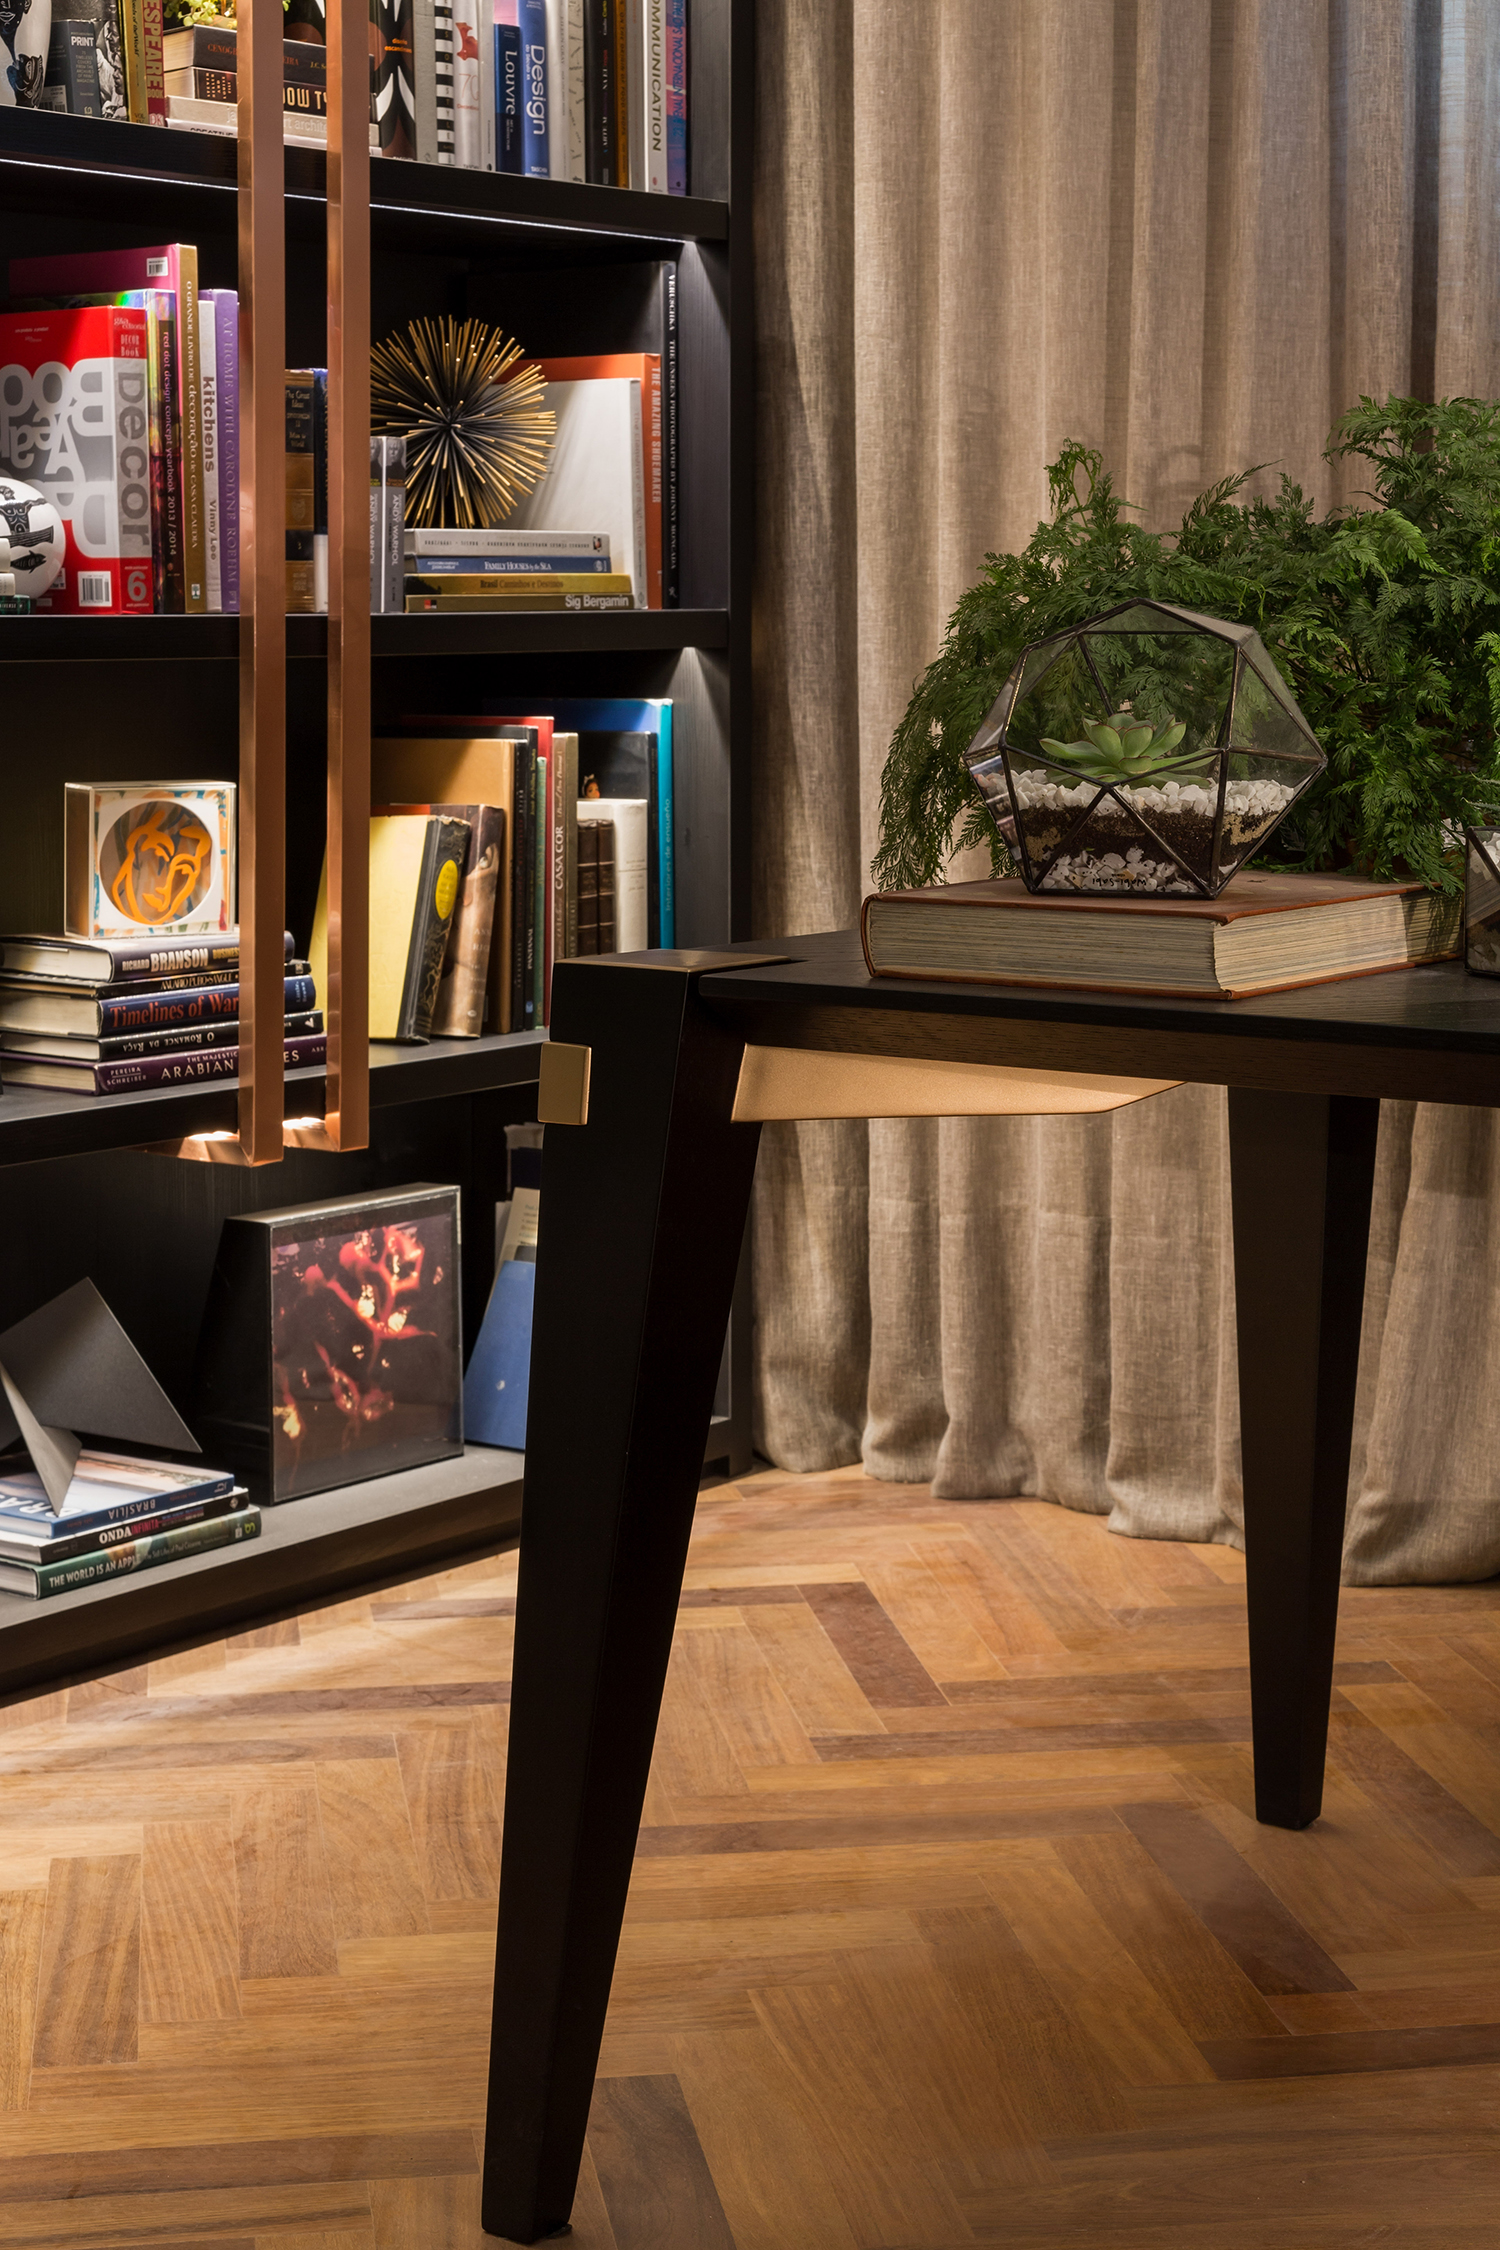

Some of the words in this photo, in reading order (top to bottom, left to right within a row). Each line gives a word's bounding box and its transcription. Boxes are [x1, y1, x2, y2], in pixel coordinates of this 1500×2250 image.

[71, 36, 94, 47] PRINT
[504, 50, 518, 115] Louvre
[525, 45, 546, 135] Design
[149, 113, 164, 126] DK
[668, 274, 676, 331] VERUSCHKA
[163, 350, 171, 368] dot
[188, 367, 195, 382] DE
[223, 342, 234, 388] HOME
[162, 370, 173, 403] design
[651, 366, 661, 386] THE
[163, 405, 174, 445] concept
[187, 384, 199, 459] decoração
[202, 375, 216, 473] kitchens
[224, 393, 236, 434] WITH
[651, 389, 661, 437] AMAZING
[117, 371, 151, 547] Decor
[165, 447, 176, 494] yearbook
[651, 440, 661, 504] SHOEMAKER
[225, 439, 237, 521] CAROLYNE
[168, 495, 176, 522] 2013
[208, 498, 217, 535] Vinny
[168, 530, 177, 556] 2014
[190, 507, 198, 548] CLAUDIA
[226, 526, 239, 583] ROEHM
[391, 524, 399, 566] WARHOL
[484, 561, 505, 570] FAMILY
[506, 561, 529, 570] HOUSES
[540, 561, 552, 570] SEA
[127, 571, 147, 602] 6
[480, 579, 498, 588] Brasil
[499, 580, 531, 588] Caminhos
[537, 580, 564, 588] Destinos
[565, 595, 581, 612] Sig
[583, 594, 630, 610] Bergamin
[555, 825, 564, 853] COR
[664, 846, 672, 857] de
[555, 856, 564, 890] CASA
[664, 861, 672, 912] Interiores
[122, 958, 150, 971] RICHARD
[150, 947, 209, 973] BRANSON
[526, 927, 534, 970] PANTANAL
[110, 1001, 184, 1028] Timelines
[188, 995, 205, 1018] of
[207, 992, 240, 1014] War
[207, 1032, 215, 1041] O
[110, 1066, 141, 1076] PEREIRA
[161, 1059, 234, 1080] ARABIAN
[187, 1055, 201, 1063] THE
[202, 1050, 238, 1061] MAJESTIC
[106, 1074, 147, 1086] SCHREIBER
[107, 1498, 156, 1520] BRASÍLIA
[99, 1526, 132, 1544] ONDA
[131, 1518, 160, 1535] INFINITA
[48, 1576, 65, 1588] THE
[66, 1567, 95, 1583] WORLD
[96, 1564, 104, 1575] IS
[105, 1560, 116, 1573] AN
[117, 1554, 140, 1570] APPLE
